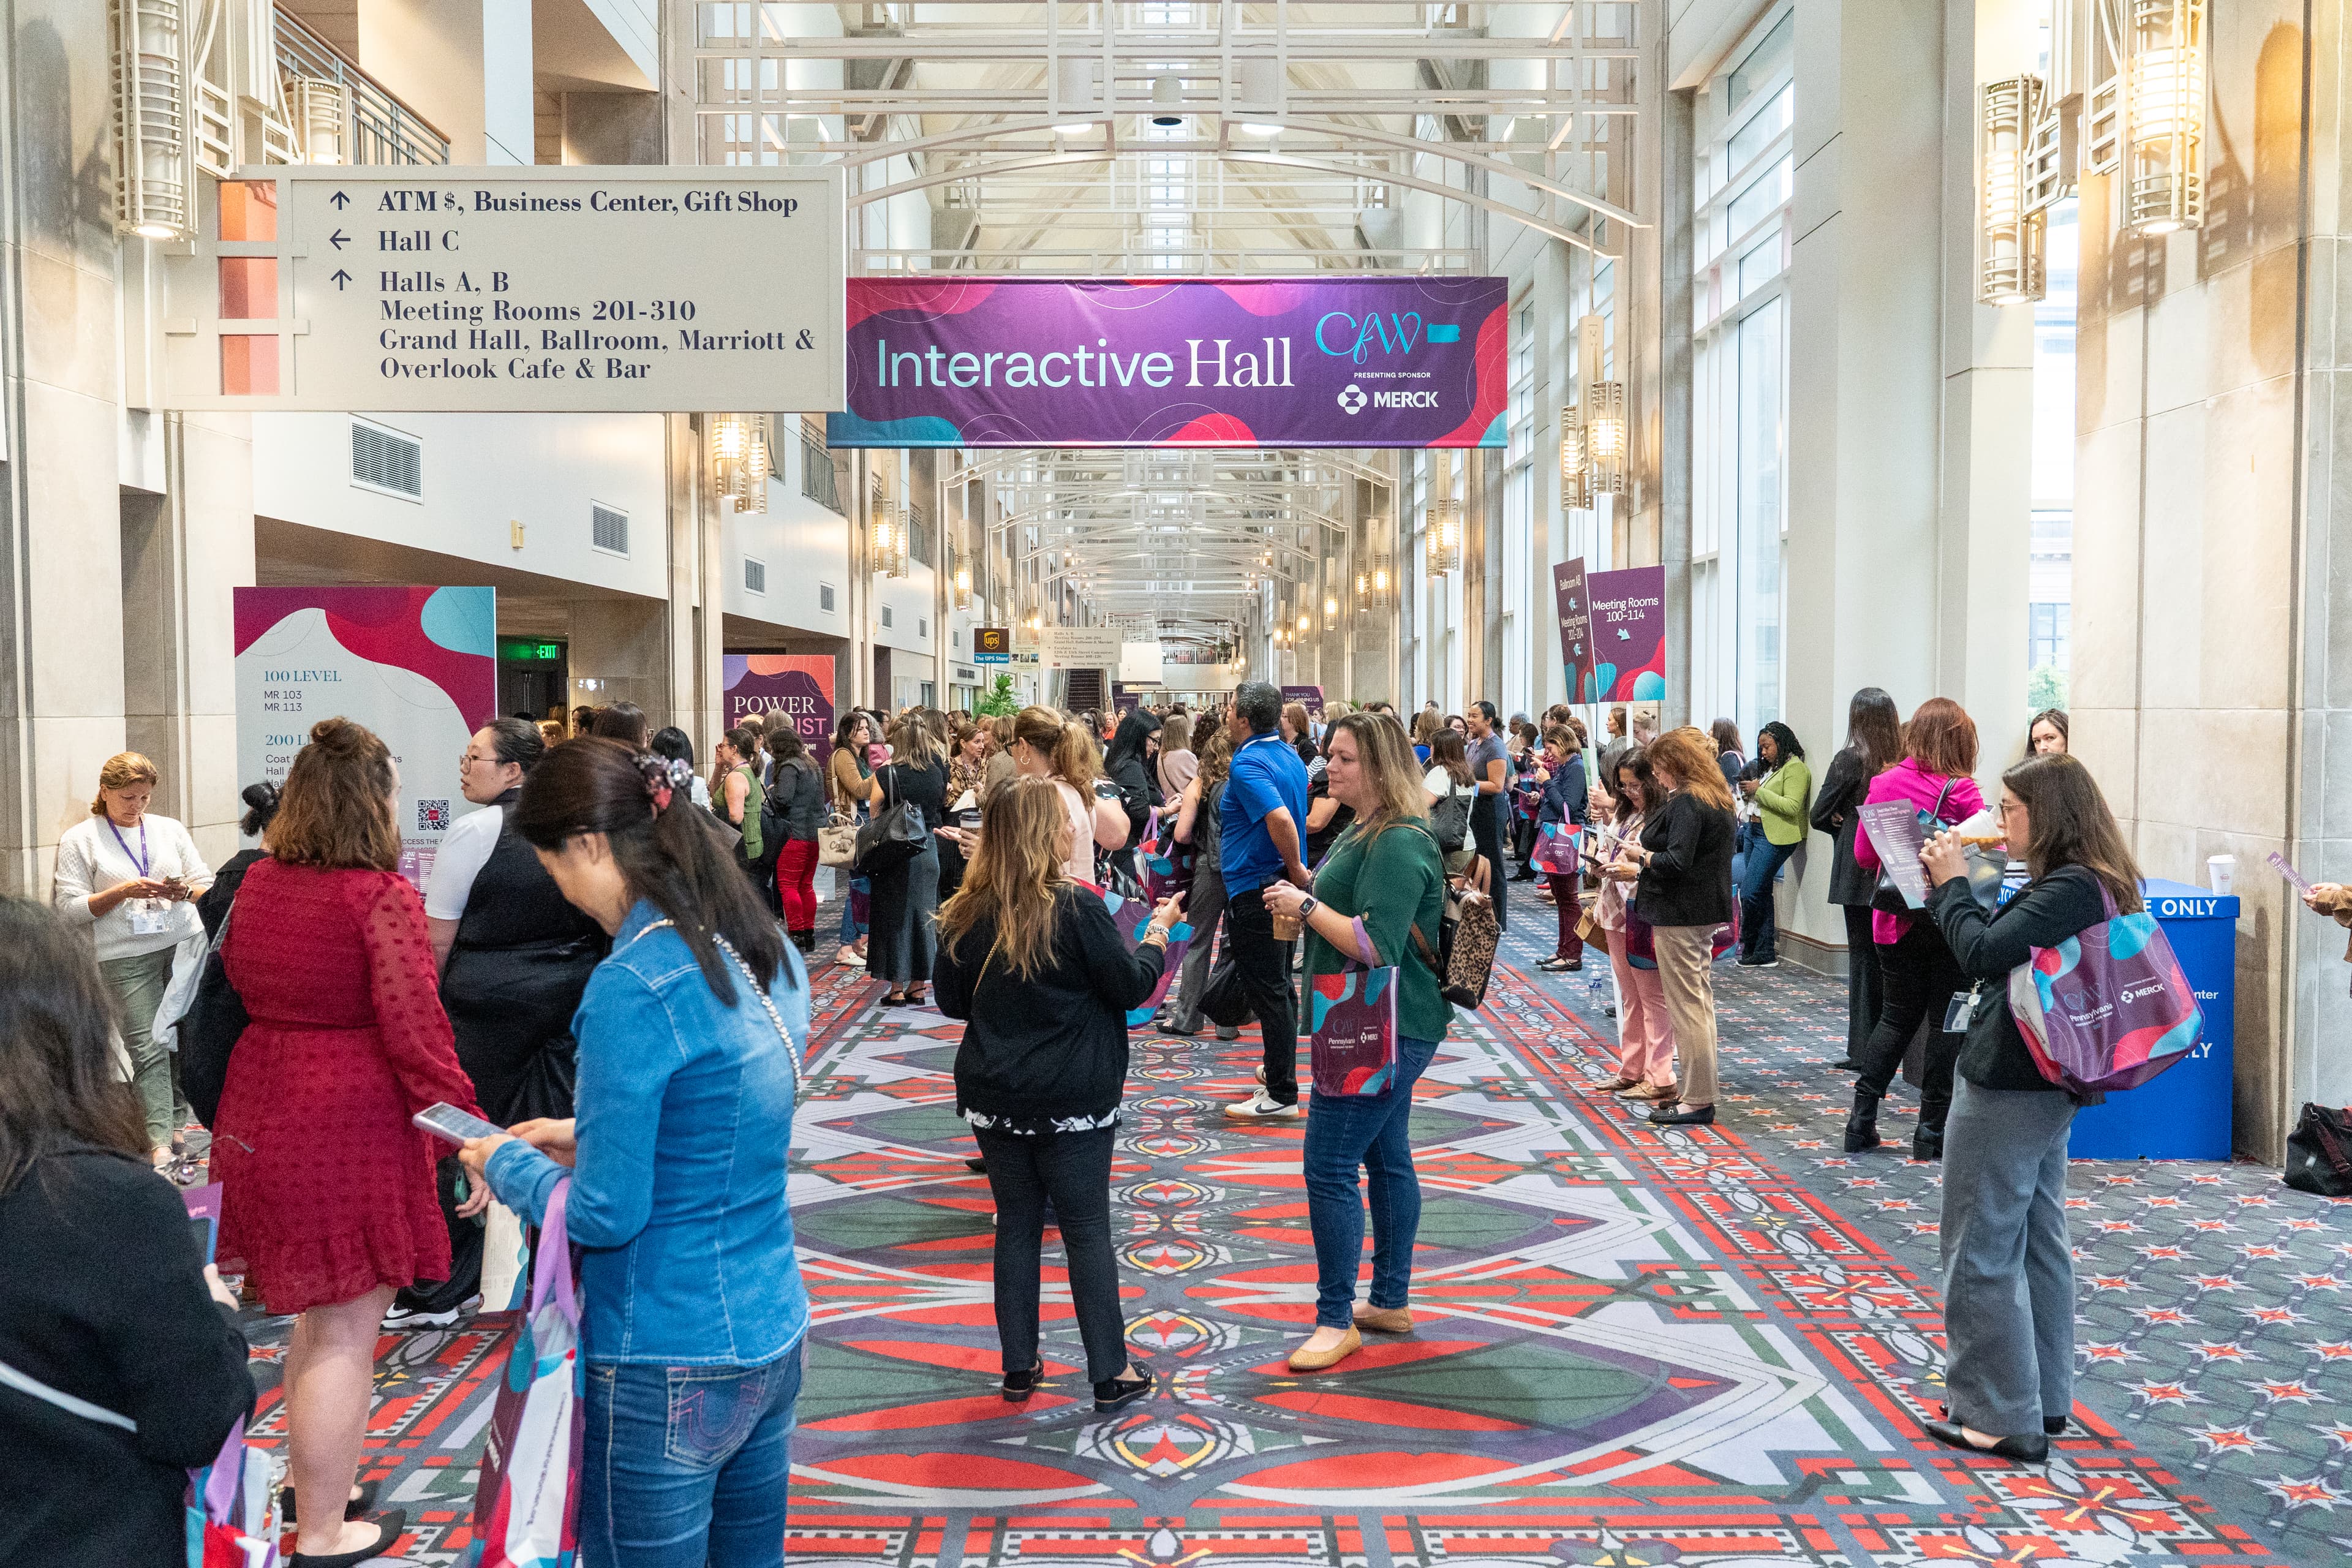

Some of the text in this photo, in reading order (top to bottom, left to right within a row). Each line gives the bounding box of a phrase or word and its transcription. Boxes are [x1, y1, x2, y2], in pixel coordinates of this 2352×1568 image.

[378, 190, 799, 218] ATM $, Business Center, Gift Shop
[379, 230, 459, 252] Hall C
[380, 272, 510, 296] Halls A, B
[380, 300, 696, 327] Meeting Rooms 201-310
[380, 330, 815, 354] Grand Hall, Ballroom, Marriott &
[380, 358, 652, 379] Overlook Cafe & Bar
[878, 337, 1295, 388] Interactive Hall
[1374, 391, 1439, 408] MERCK
[1559, 575, 1581, 590] Ballroom AB
[1593, 597, 1659, 611] Meeting Rooms
[1561, 614, 1588, 628] Meeting Rooms
[1606, 609, 1645, 622] 100-114
[985, 637, 998, 647] ups
[540, 645, 557, 659] EXIT
[265, 671, 342, 682] 100 LEVEL
[265, 691, 303, 699] MR 103
[265, 703, 303, 712] MR 113
[733, 696, 817, 714] POWER
[265, 734, 294, 746] 200
[266, 754, 290, 764] Coat
[266, 766, 285, 775] Hall
[2161, 899, 2217, 916] ONLY
[2135, 983, 2165, 998] MERCK
[2194, 990, 2218, 999] nter
[2069, 1003, 2113, 1023] Pennsylvania
[2185, 1042, 2212, 1058] LY
